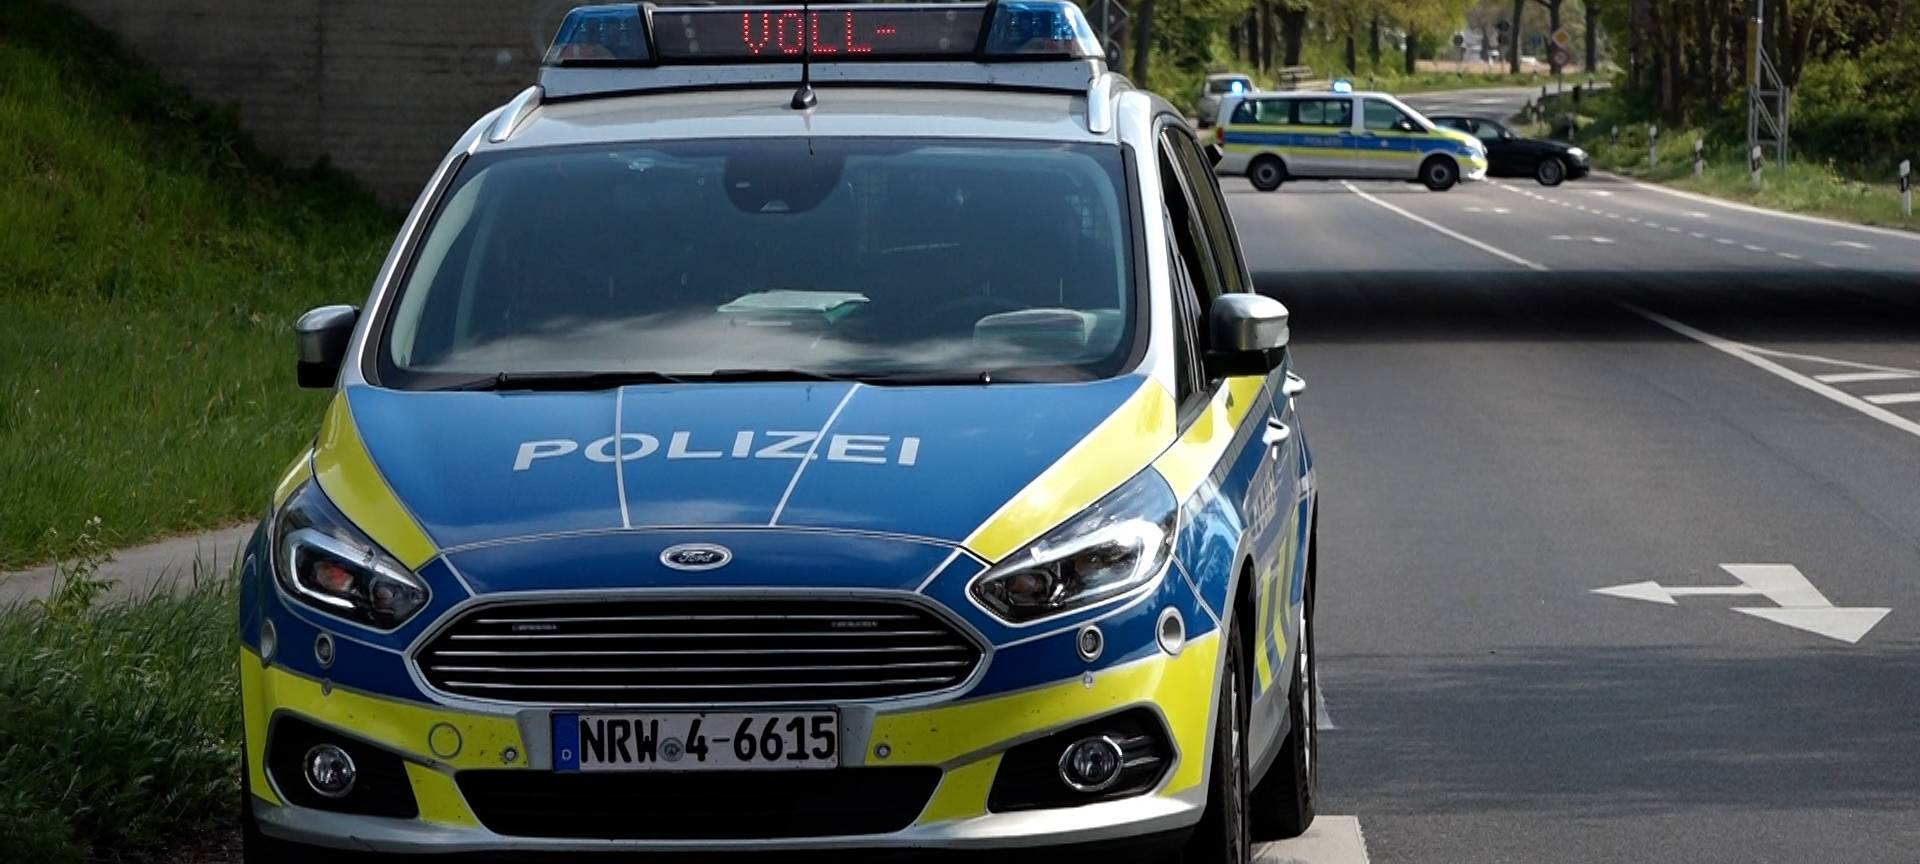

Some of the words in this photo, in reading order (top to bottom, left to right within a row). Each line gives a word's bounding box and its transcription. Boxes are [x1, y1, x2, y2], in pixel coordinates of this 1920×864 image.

[743, 11, 896, 54] VOLL-
[513, 431, 921, 471] POLIZEI
[678, 551, 714, 563] Ford
[561, 749, 572, 761] D
[579, 718, 659, 763] NRW
[685, 716, 836, 762] 4-6615
